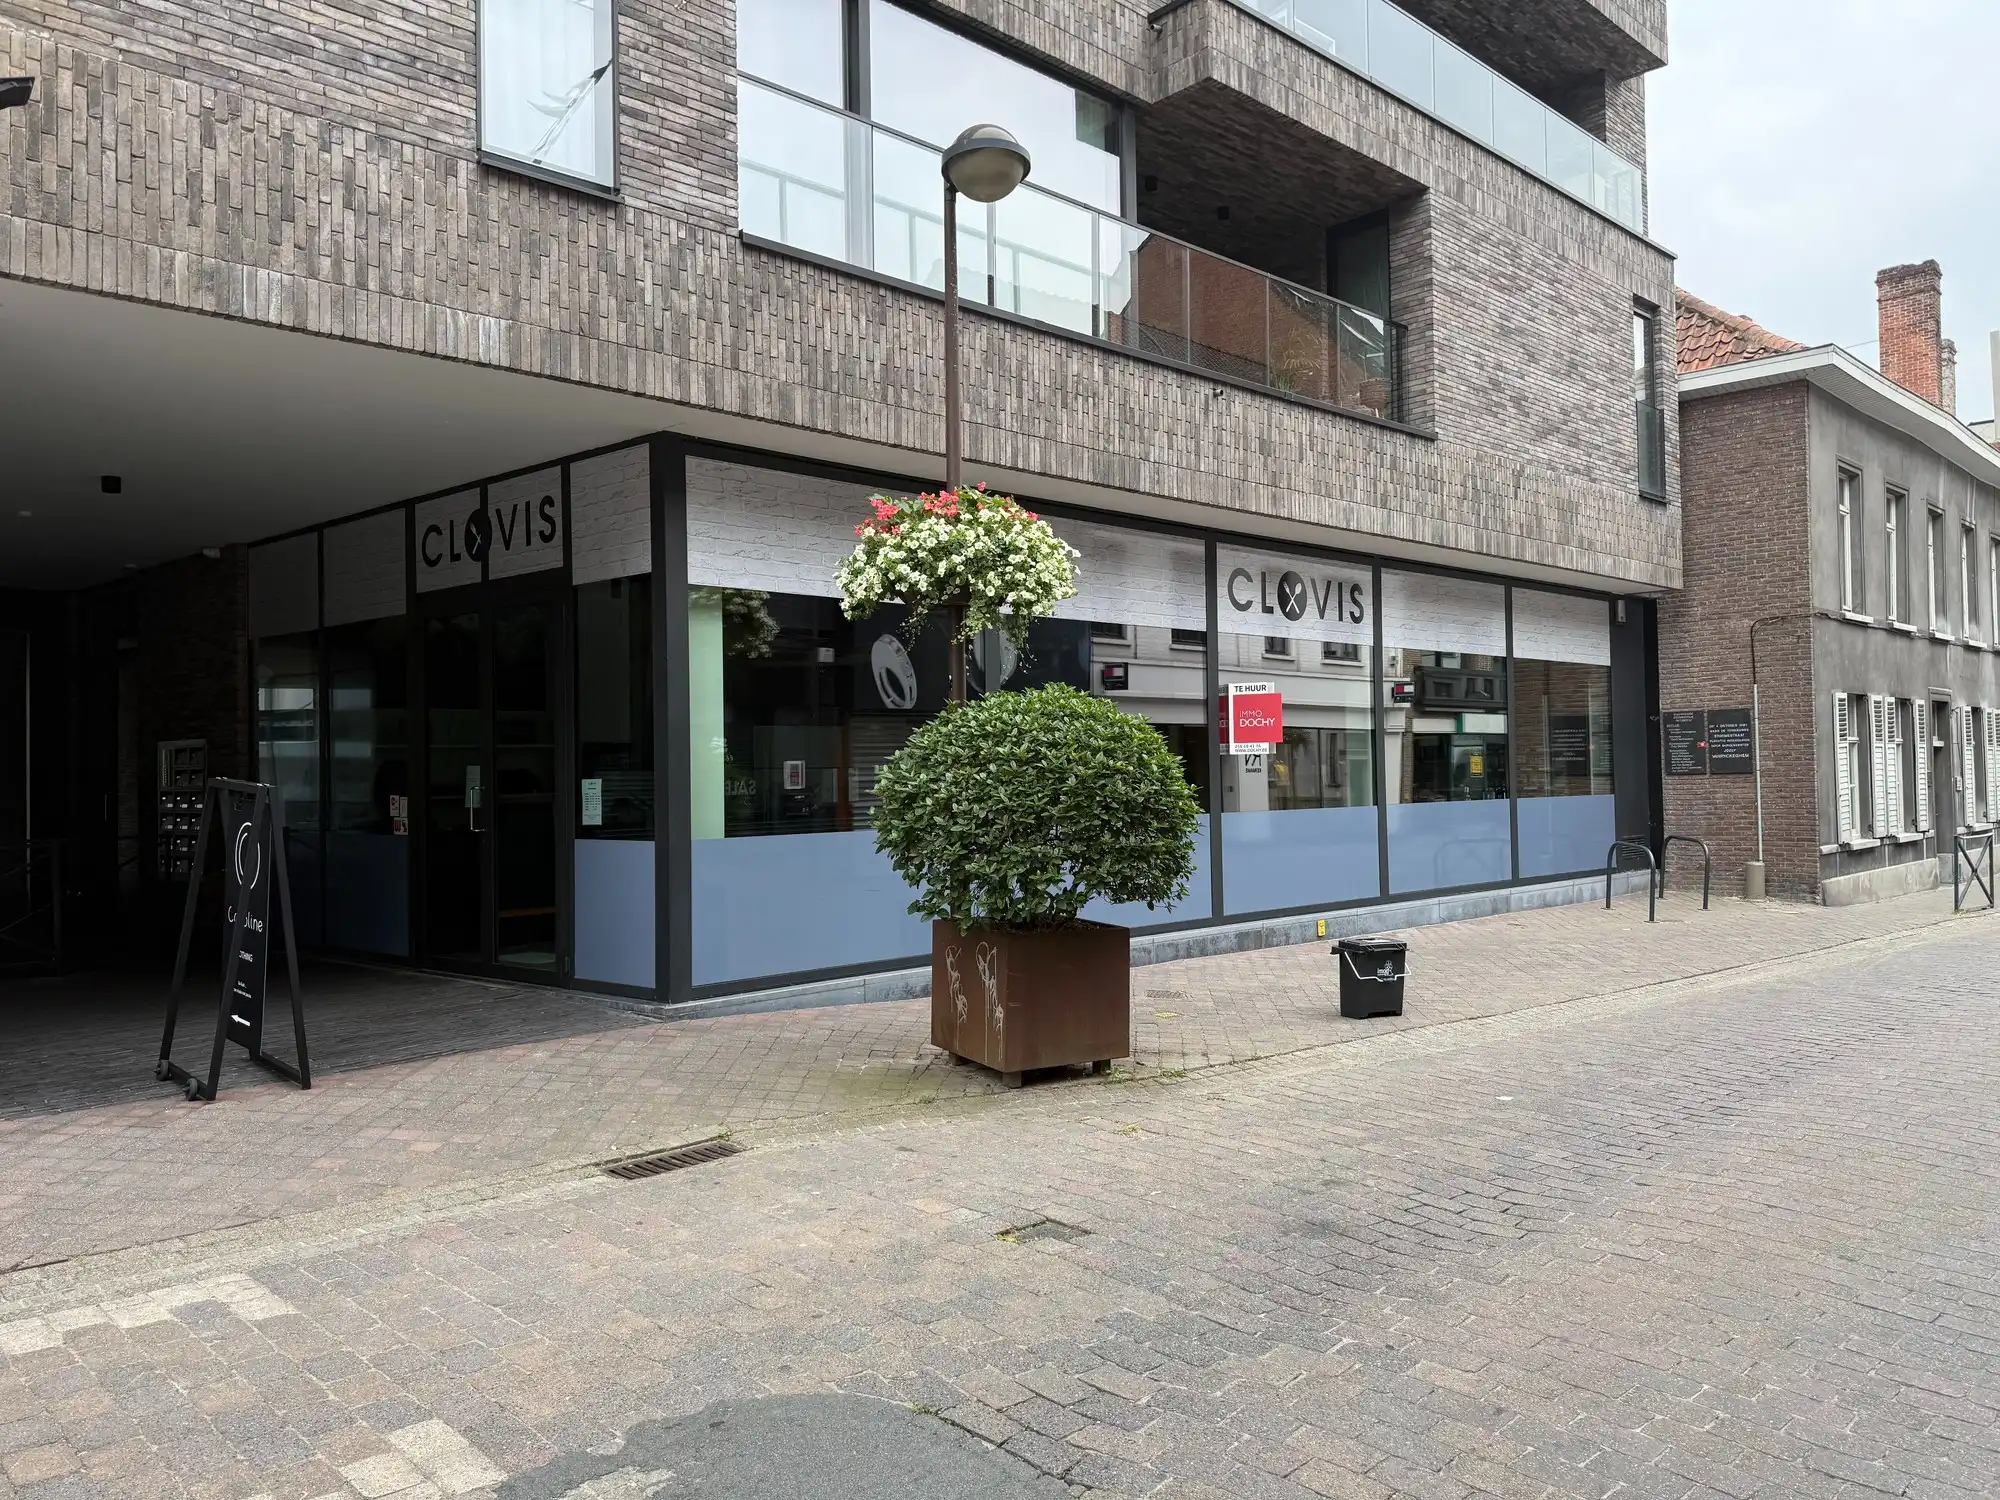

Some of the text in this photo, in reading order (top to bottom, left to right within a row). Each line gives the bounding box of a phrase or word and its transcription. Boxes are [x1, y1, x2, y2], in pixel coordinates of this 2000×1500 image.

[421, 494, 557, 568] CLOVIS
[1227, 567, 1365, 625] CLOVIS
[1245, 684, 1267, 692] HUUR
[1240, 718, 1275, 727] DOCHY
[227, 905, 263, 932] Cline
